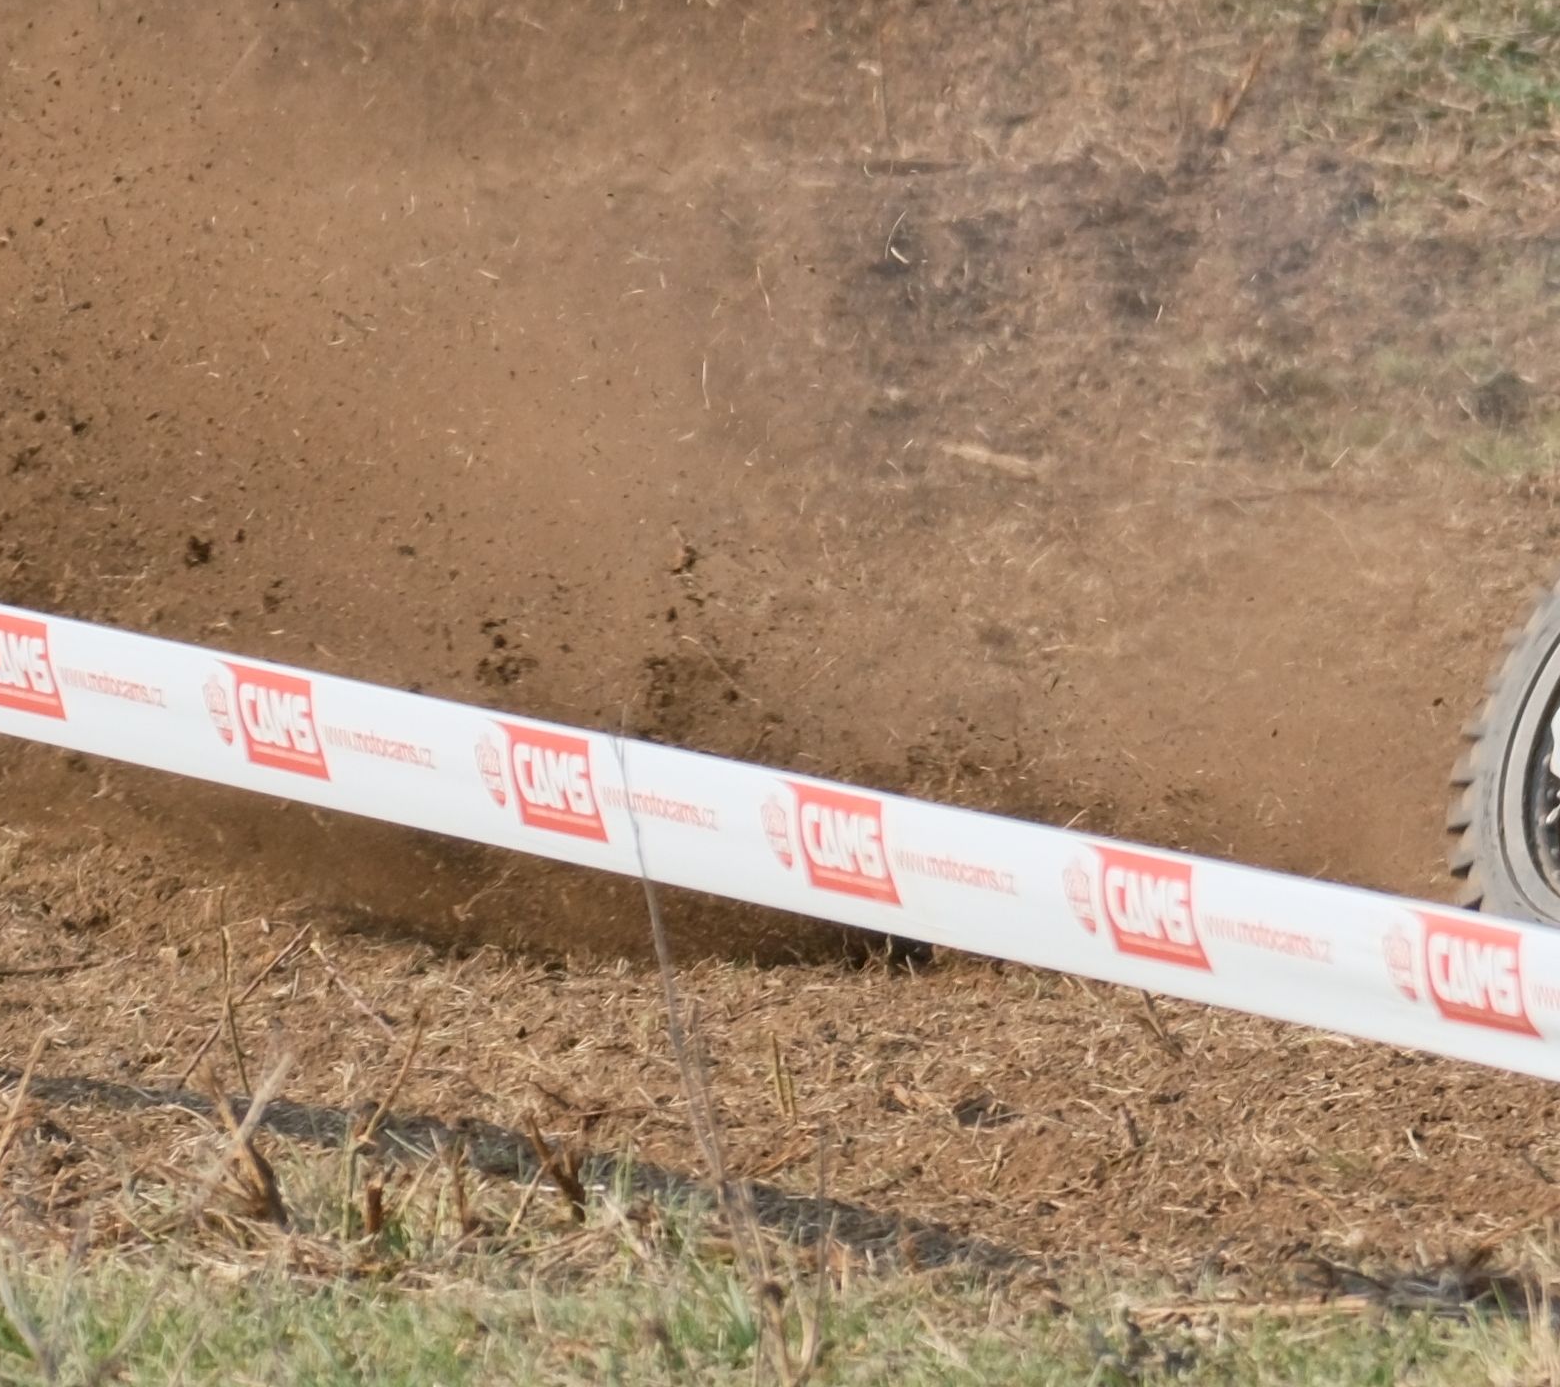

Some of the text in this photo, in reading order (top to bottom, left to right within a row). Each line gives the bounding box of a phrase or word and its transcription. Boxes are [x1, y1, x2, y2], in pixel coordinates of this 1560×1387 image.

[238, 682, 320, 755] CAMS
[512, 742, 598, 817] CAMS
[800, 802, 889, 879] CAMS
[1103, 865, 1195, 948] CAMS
[1426, 932, 1524, 1019] CAMS
